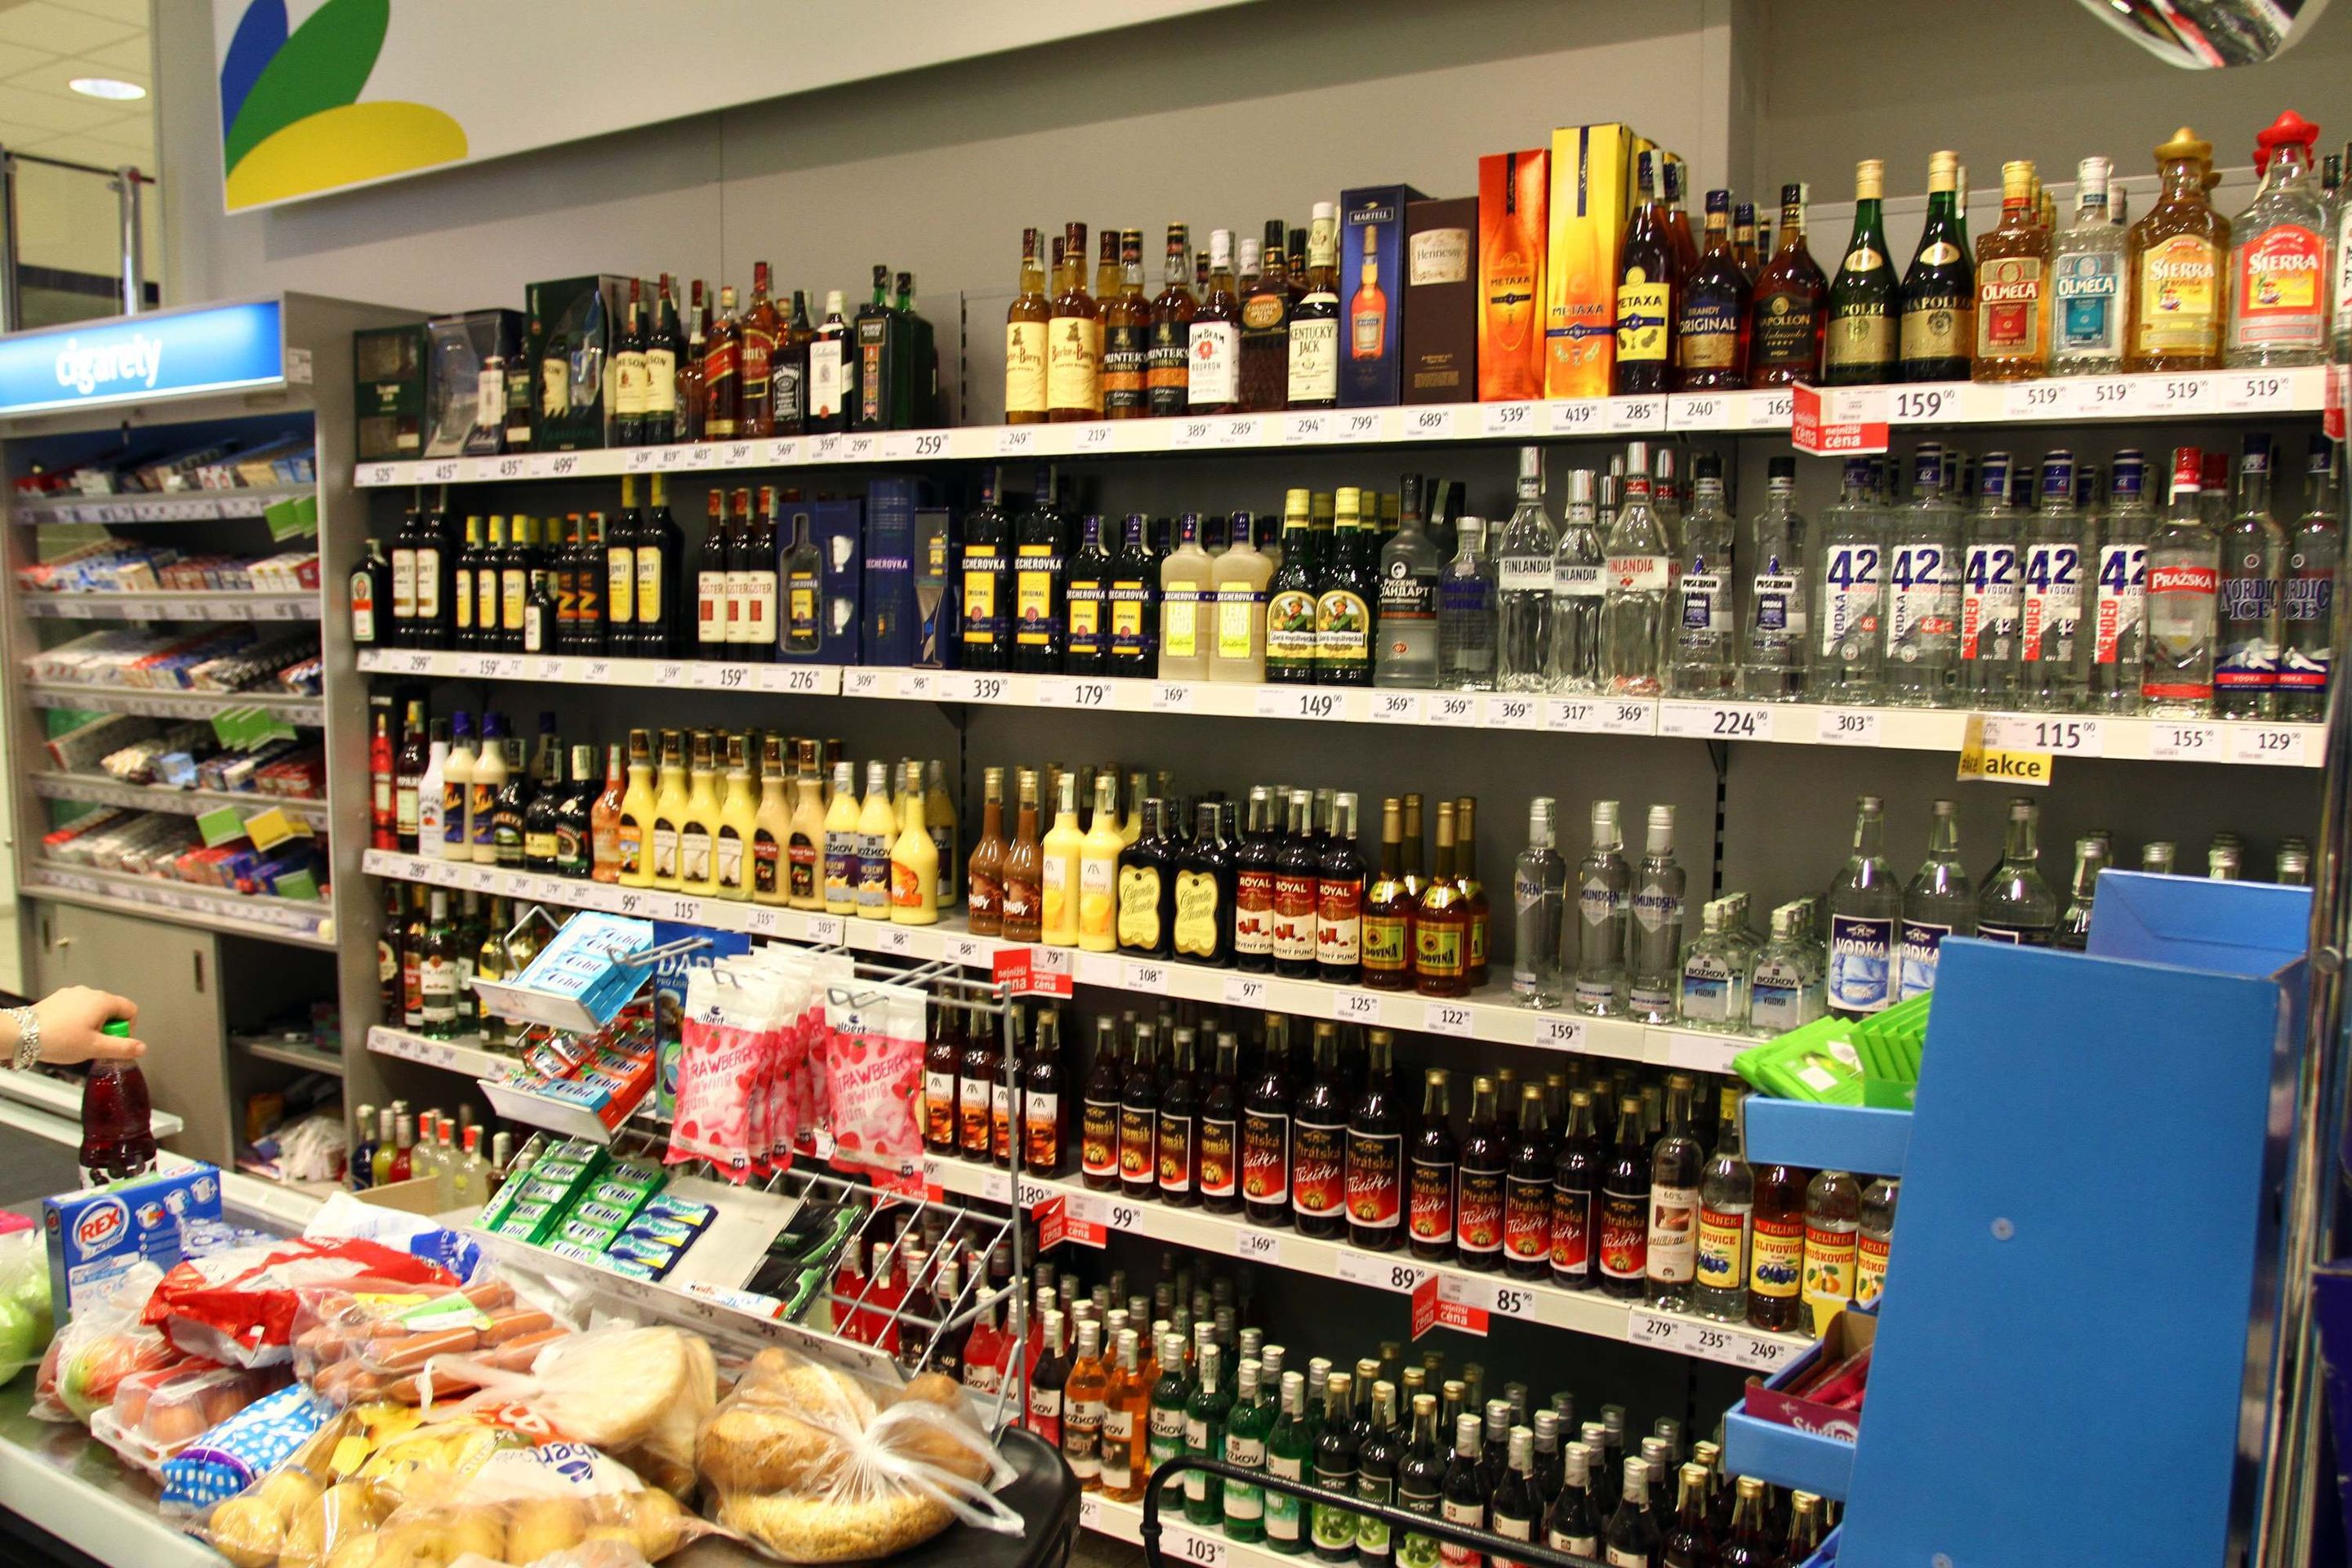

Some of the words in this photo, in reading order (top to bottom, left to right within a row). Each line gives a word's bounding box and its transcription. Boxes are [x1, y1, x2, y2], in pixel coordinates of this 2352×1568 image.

[1353, 211, 1388, 221] MARTELL
[1417, 247, 1460, 261] Hennessy
[2248, 249, 2318, 275] SIERRA
[2150, 259, 2215, 281] SIERRA
[1490, 275, 1530, 287] METAXA
[2059, 277, 2114, 295] OLMECA
[1982, 281, 2037, 301] OLMECA
[1552, 304, 1604, 317] METAXA
[1689, 306, 1720, 315] BRANDY
[1680, 318, 1736, 334] ORIGINAL
[1189, 334, 1203, 345] JIM
[1204, 329, 1224, 345] BEAM
[1298, 340, 1321, 354] JACK
[56, 334, 162, 394] cigarety
[2096, 385, 2126, 401] 519
[2167, 384, 2198, 399] 519
[2246, 380, 2277, 397] 519
[2028, 388, 2056, 404] 519
[1627, 405, 1650, 418] 285
[1687, 402, 1713, 416] 240
[1768, 400, 1793, 415] 165
[1897, 392, 1941, 417] 159
[1419, 413, 1441, 426] 689
[1500, 408, 1522, 421] 539
[1566, 408, 1588, 421] 419
[1231, 422, 1250, 434] 289
[1298, 420, 1318, 433] 294
[1352, 416, 1371, 429] 799
[1088, 430, 1105, 441] 219
[1187, 425, 1205, 437] 389
[853, 439, 867, 452] 299
[915, 436, 941, 454] 259
[1009, 433, 1026, 444] 249
[1825, 435, 1861, 447] cena
[500, 461, 518, 475] 435
[553, 459, 571, 474] 499
[1504, 560, 1551, 574] FINLANDIA
[1828, 550, 1878, 590] 42
[1892, 550, 1941, 590] 42
[1965, 550, 2015, 592] 42
[2026, 550, 2078, 593] 42
[1987, 586, 2013, 595] VODKA
[2049, 586, 2074, 595] VODKA
[2230, 600, 2270, 620] ICE
[1833, 595, 1847, 640] VODKA
[1895, 595, 1905, 642] VODKA
[720, 669, 741, 685] 159
[790, 672, 813, 688] 276
[973, 679, 1000, 698] 339
[1076, 685, 1102, 704] 179
[1164, 688, 1183, 701] 169
[1300, 696, 1333, 716] 149
[1386, 697, 1408, 710] 369
[1444, 700, 1466, 713] 369
[1503, 703, 1525, 716] 369
[1562, 706, 1585, 719] 317
[1618, 706, 1642, 720] 369
[1714, 712, 1755, 734] 224
[1838, 716, 1864, 730] 303
[2036, 724, 2079, 746] 115
[2174, 731, 2203, 746] 155
[2259, 733, 2289, 749] 129
[1985, 754, 2040, 776] akce
[1241, 877, 1271, 889] ROYAL
[1276, 881, 1307, 893] ROYAL
[1320, 885, 1349, 897] ROYAL
[1582, 889, 1619, 902] MUNDSEN
[622, 896, 635, 911] 99
[674, 902, 693, 919] 115
[960, 944, 971, 955] 88
[1837, 938, 1885, 957] VODKA
[1047, 951, 1058, 963] 79
[1139, 969, 1156, 982] 108
[1688, 965, 1725, 978] BOŽKOV
[1034, 980, 1056, 991] cena
[1757, 973, 1794, 986] BOŽKOV
[1243, 984, 1256, 996] 97
[1695, 987, 1717, 998] VODKA
[1351, 997, 1370, 1011] 125
[1763, 995, 1786, 1007] VODKA
[1442, 1010, 1463, 1024] 122
[835, 1021, 867, 1035] albert
[1552, 1025, 1573, 1039] 159
[614, 1165, 653, 1180] Orbit
[599, 1185, 637, 1200] Orbit
[582, 1204, 621, 1222] Orbit
[1113, 1208, 1132, 1227] 99
[81, 1208, 121, 1242] REX
[1068, 1226, 1089, 1240] cena
[1251, 1238, 1269, 1250] 169
[1392, 1267, 1414, 1288] 89
[1498, 1290, 1521, 1312] 85
[1441, 1312, 1468, 1325] cena
[1647, 1320, 1670, 1335] 279
[1699, 1331, 1723, 1348] 235
[1751, 1342, 1776, 1359] 249
[1187, 1537, 1215, 1561] 103
